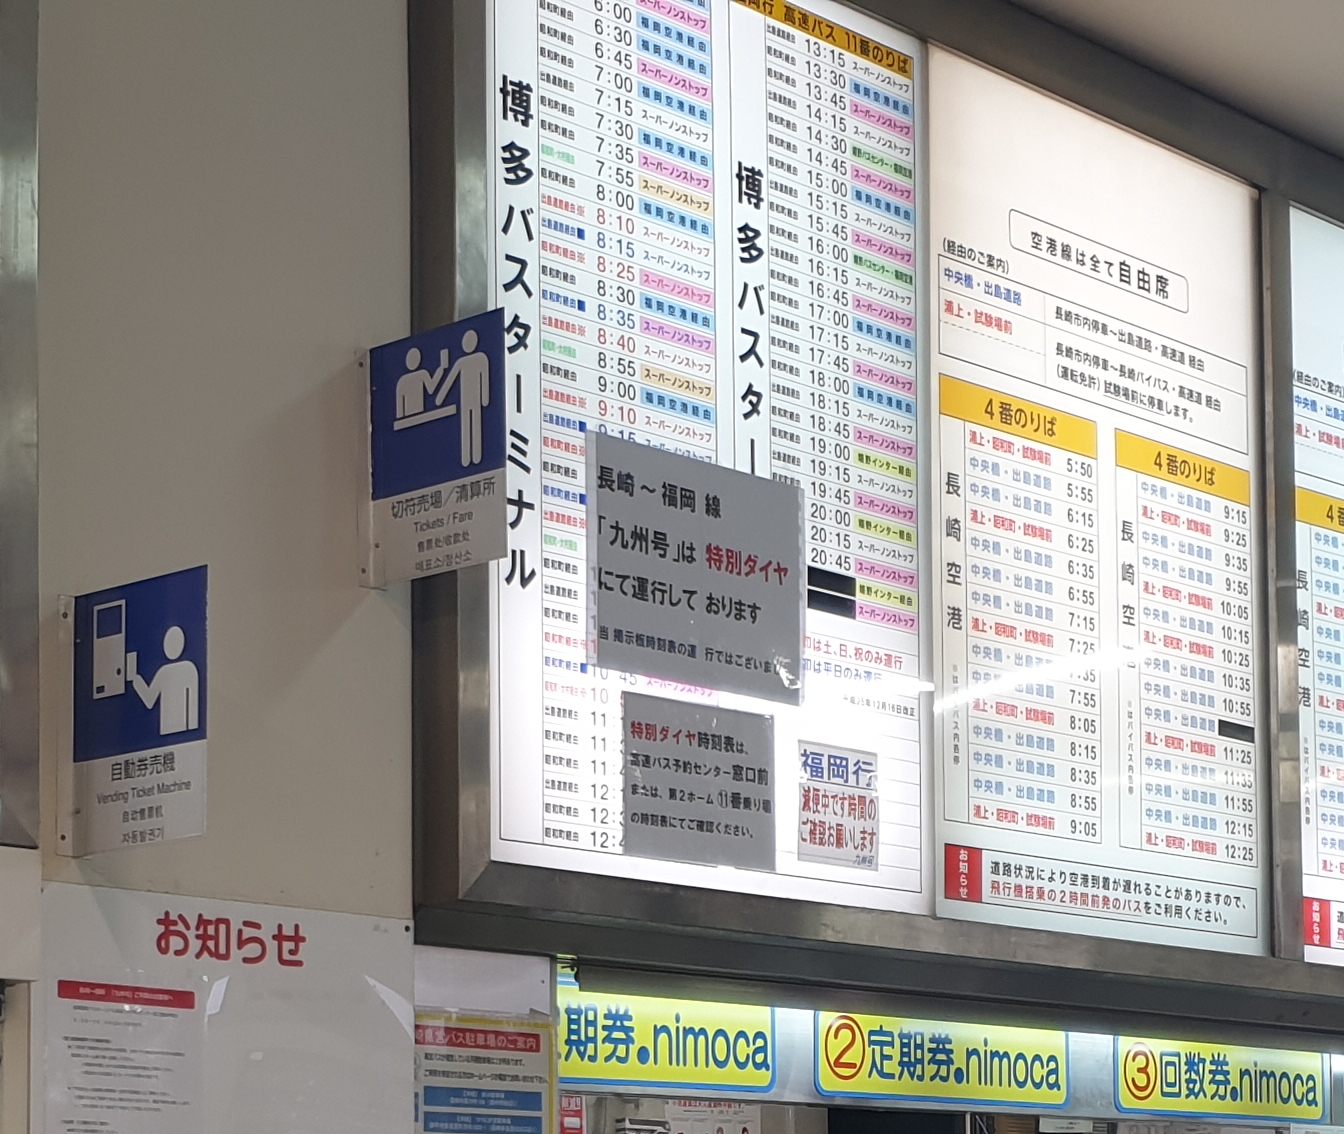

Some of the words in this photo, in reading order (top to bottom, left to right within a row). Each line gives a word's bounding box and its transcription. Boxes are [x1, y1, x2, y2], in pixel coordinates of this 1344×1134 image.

[594, 20, 632, 47] 6:30
[784, 5, 836, 42] 高速バス
[845, 32, 909, 73] 11番のりば
[805, 39, 846, 67] 13:15
[595, 66, 633, 93] 7:00
[641, 86, 707, 121] 福岡空港経由
[641, 62, 708, 97] スーパーノンストップ
[806, 125, 846, 154] 14:30
[942, 237, 1010, 274] (経由のご案内)
[1030, 230, 1170, 300] 空港線は全て自由席
[643, 271, 713, 306] スーパーノンストップ
[944, 266, 1022, 306] 中央橋・出島道路
[499, 74, 538, 590] 博多バスターミナル
[944, 299, 1013, 336] 浦上・試験場前
[598, 376, 636, 402] 9:00
[809, 390, 850, 418] 18:15
[1103, 379, 1194, 423] 試験場前に停車します。
[984, 398, 1057, 438] 4番のりば
[969, 456, 1053, 491] 中央橋・出島道路
[1067, 483, 1093, 504] 5:55
[1154, 450, 1216, 486] 4番のりば
[414, 517, 445, 534] Tickets
[453, 510, 474, 525] Fare
[705, 493, 722, 519] 線
[1224, 505, 1247, 525] 9:15
[598, 515, 697, 565] 「九州号」は
[706, 543, 789, 586] 特別ダイヤ
[944, 471, 963, 632] 長崎空港
[598, 566, 698, 612] にて運行して
[706, 592, 761, 625] おります
[613, 628, 697, 659] 掲示板時刻表の運
[705, 647, 782, 675] 行ではございま
[630, 720, 749, 755] 特別ダイヤ時刻表は、
[110, 751, 176, 782] 自動券売機
[630, 753, 769, 785] 高速バス予約センター窓口前
[801, 749, 874, 786] 福岡行
[96, 788, 129, 805] Vending
[131, 783, 154, 799] Ticket
[157, 779, 191, 794] Machine
[802, 786, 877, 821] 減便中です時間の
[631, 811, 754, 838] の時刻表にてご確認ください。
[801, 819, 877, 853] ご確認お願いします
[1225, 843, 1254, 863] 12:25
[958, 849, 969, 898] お知らせ
[990, 860, 1246, 909] 道路状況により空港到着が遅れることがありますので、
[990, 880, 1230, 926] 飛行機搭乗の2時間前発のバスをご利用ください。
[156, 910, 307, 968] お知らせ
